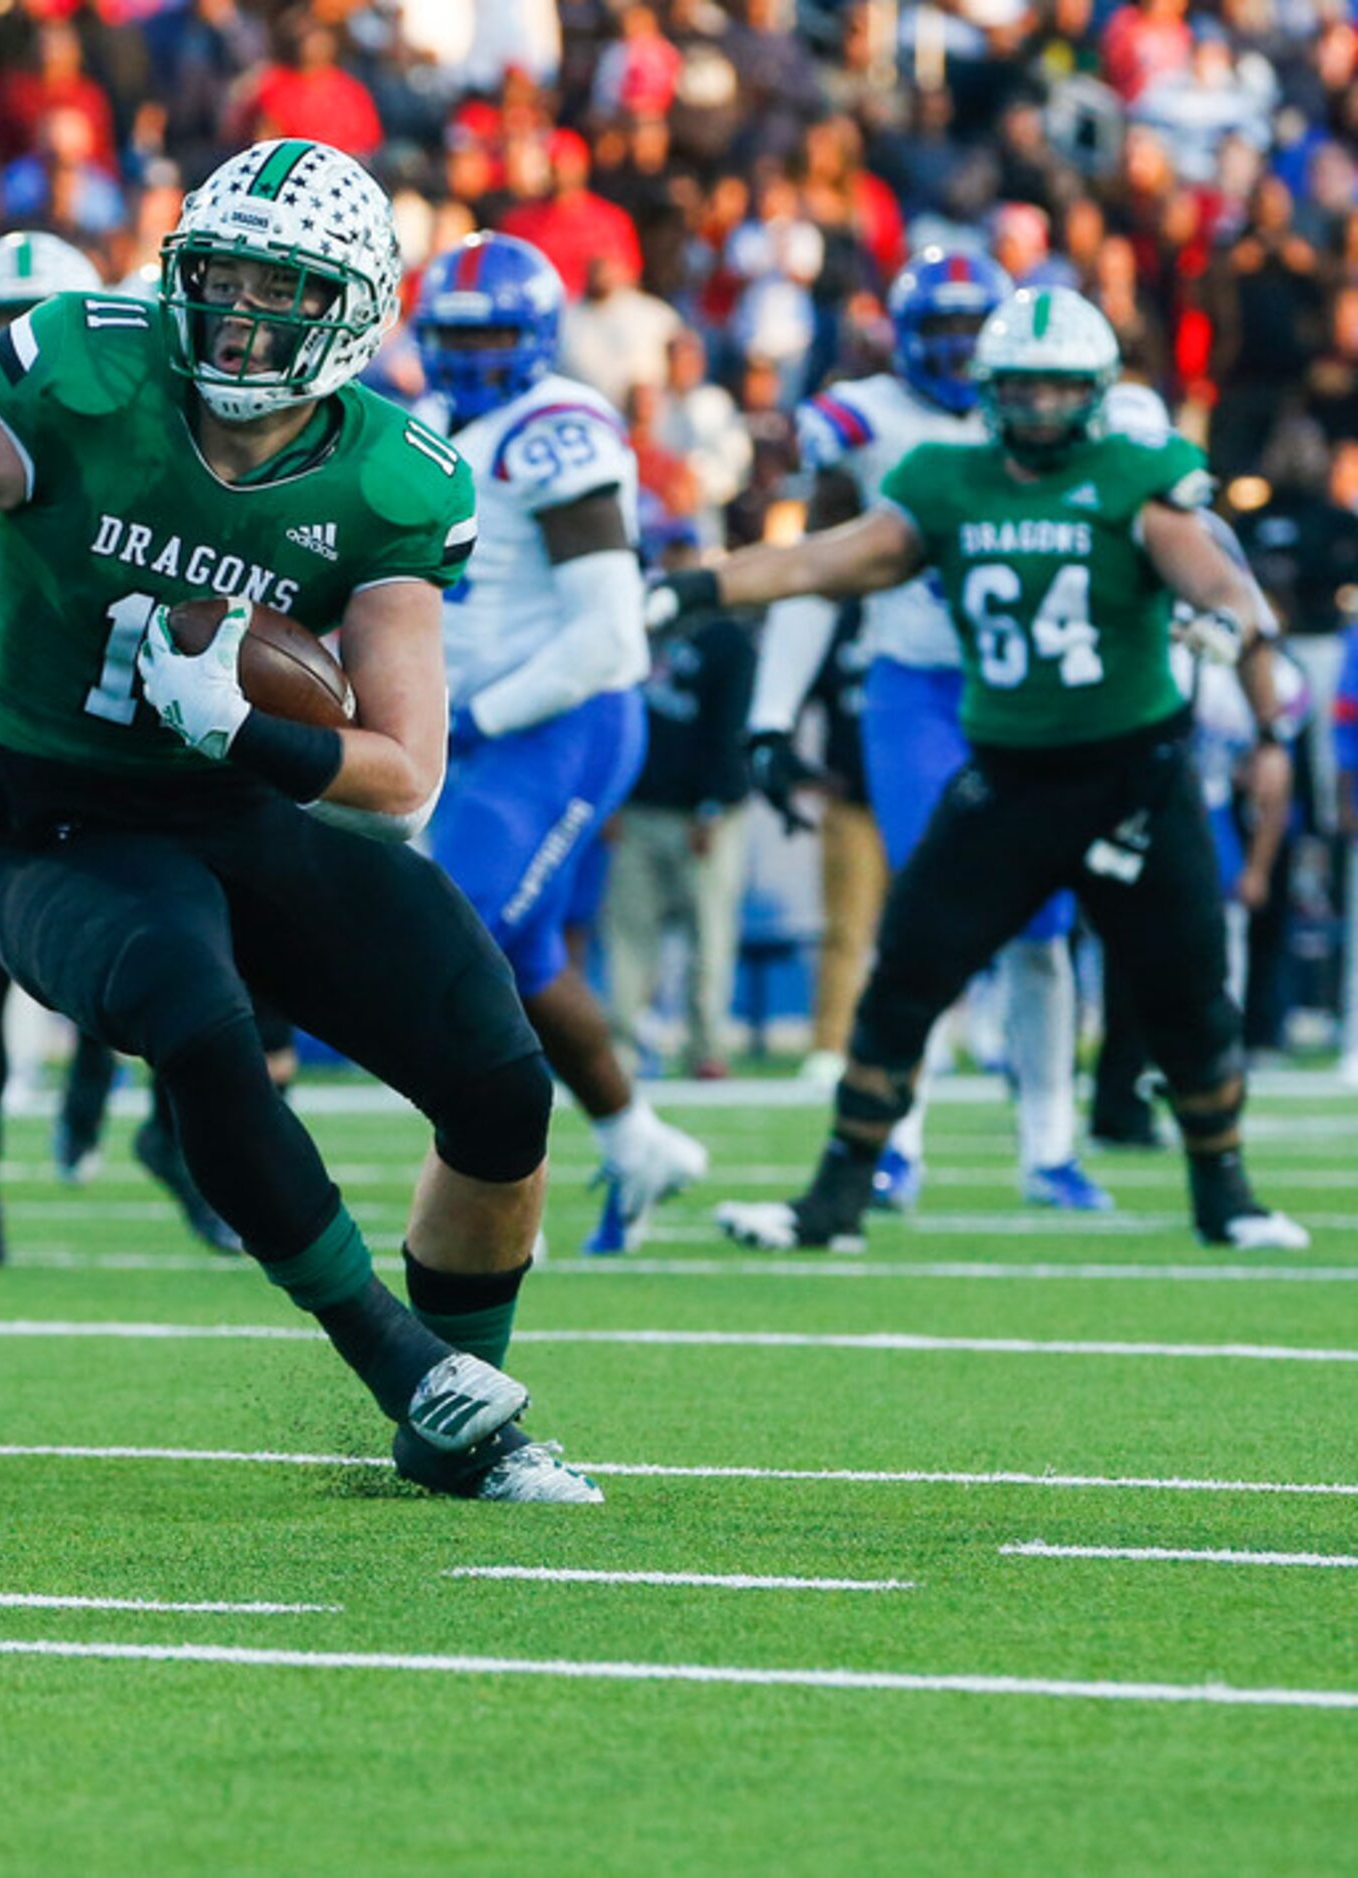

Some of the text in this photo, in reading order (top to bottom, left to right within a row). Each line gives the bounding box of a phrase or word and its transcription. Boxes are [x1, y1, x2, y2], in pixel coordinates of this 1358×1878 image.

[85, 299, 149, 327] 11
[405, 419, 458, 476] 11
[523, 421, 596, 491] 99
[92, 515, 299, 613] DRAGONS
[286, 528, 339, 561] adidas
[85, 592, 153, 726] 1
[965, 564, 1103, 688] 64
